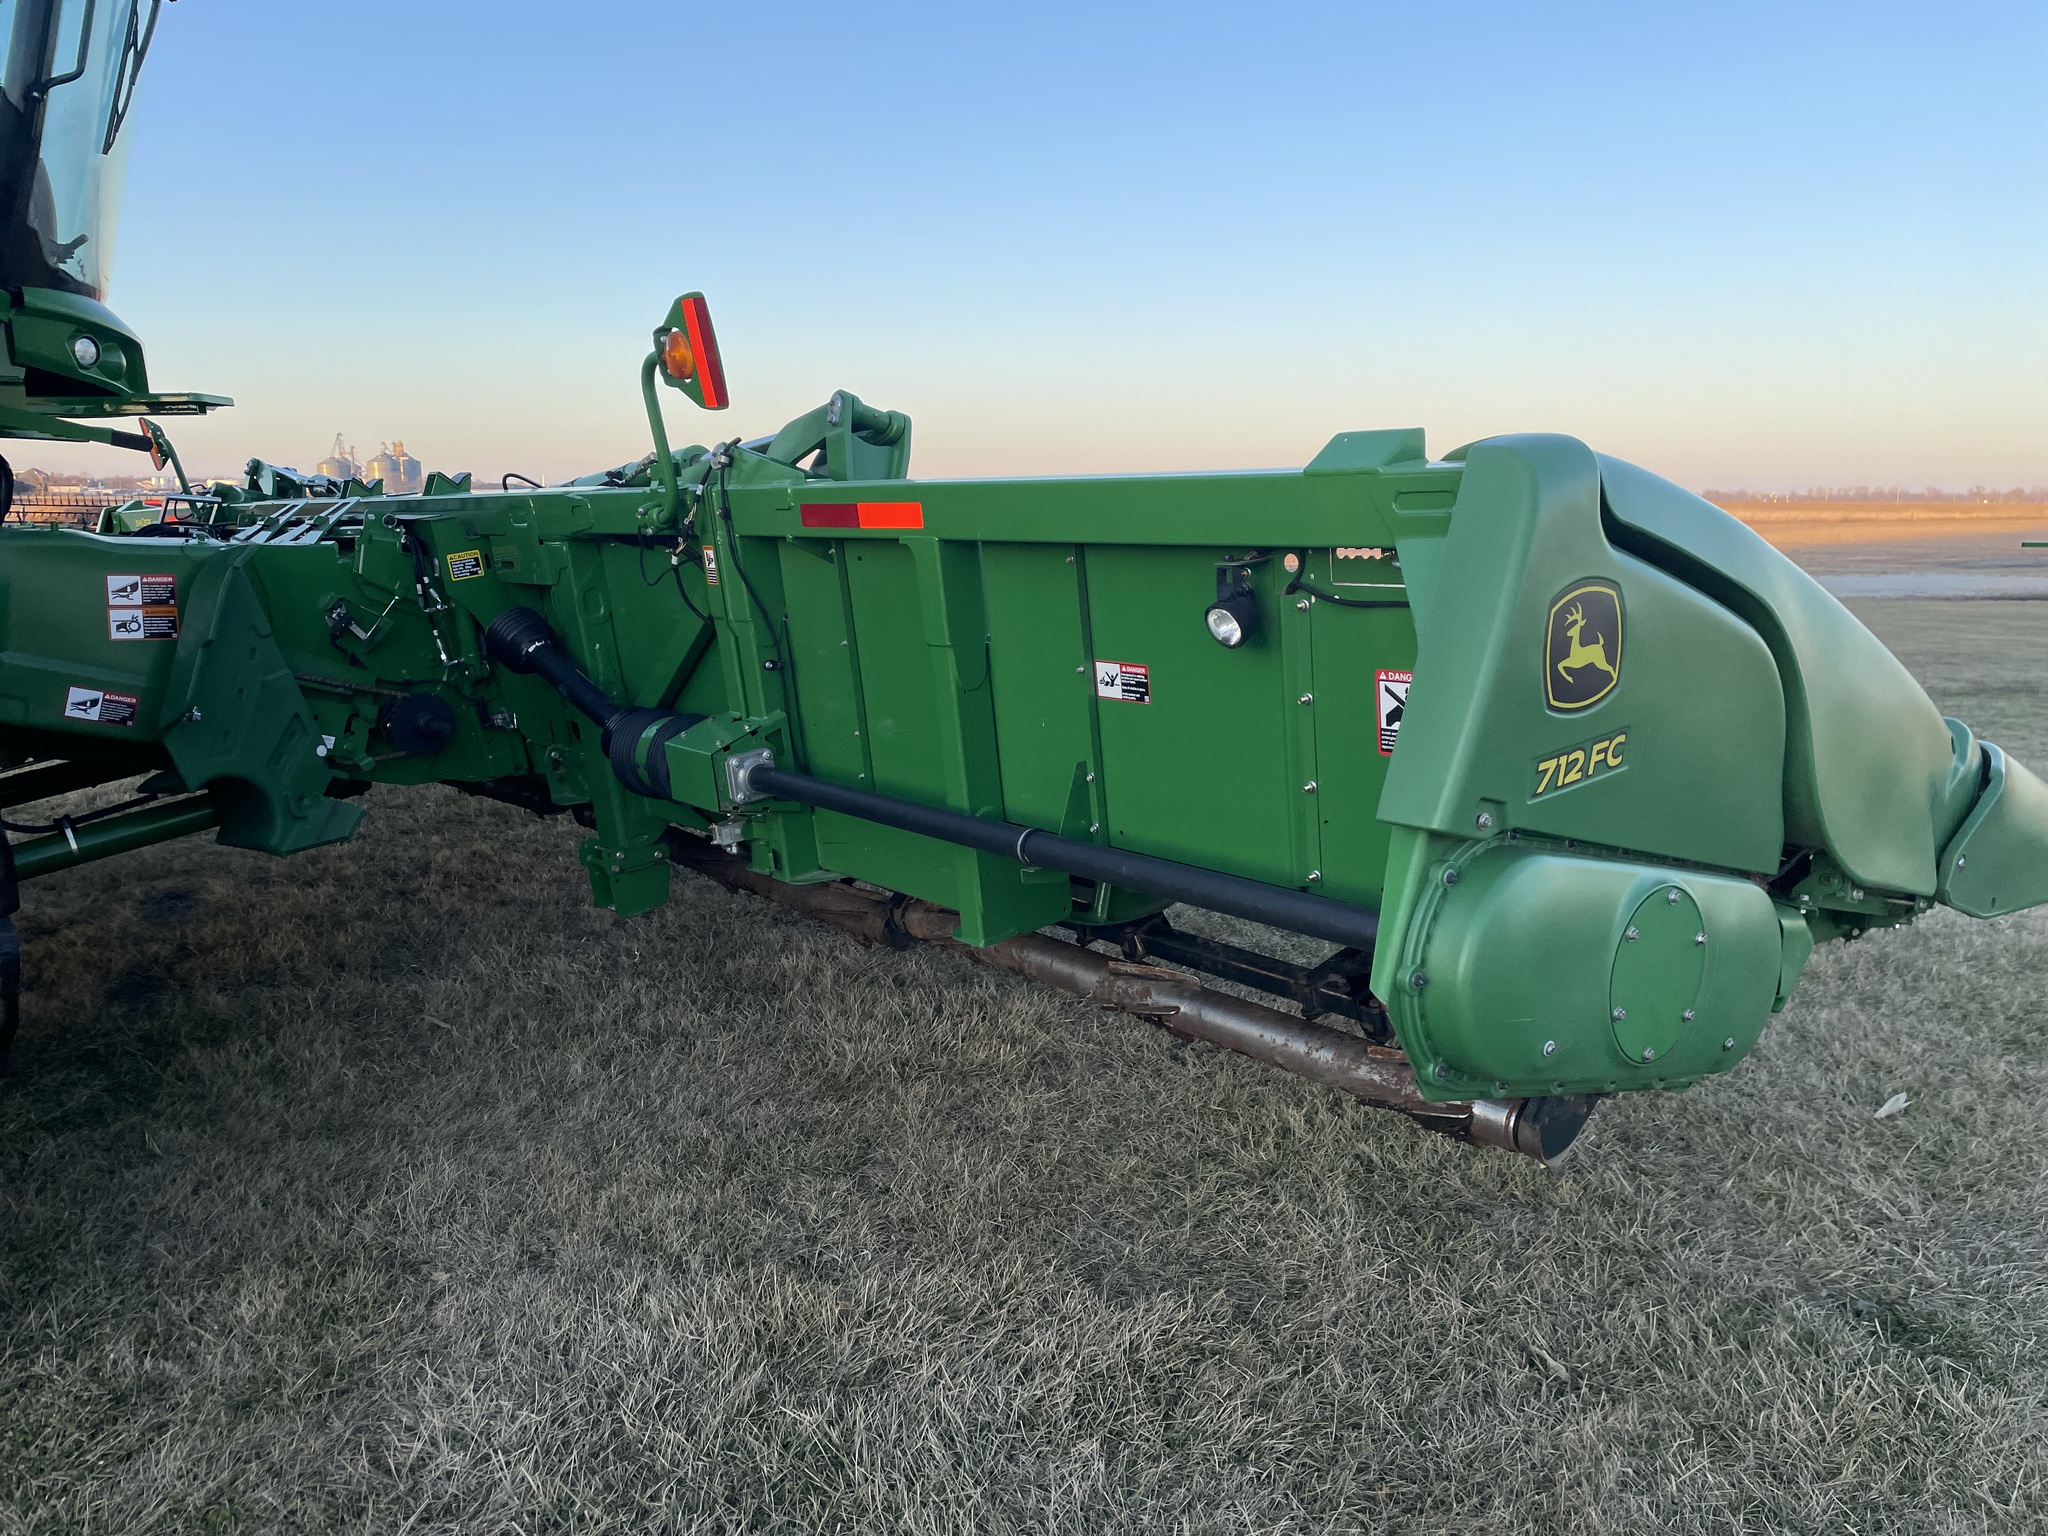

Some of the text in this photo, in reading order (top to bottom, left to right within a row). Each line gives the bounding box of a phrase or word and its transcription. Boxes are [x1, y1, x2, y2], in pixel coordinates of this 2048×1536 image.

[453, 551, 479, 560] CAUTION
[1126, 666, 1146, 674] DANGER
[1388, 672, 1412, 681] DANG
[110, 694, 137, 704] DANGER
